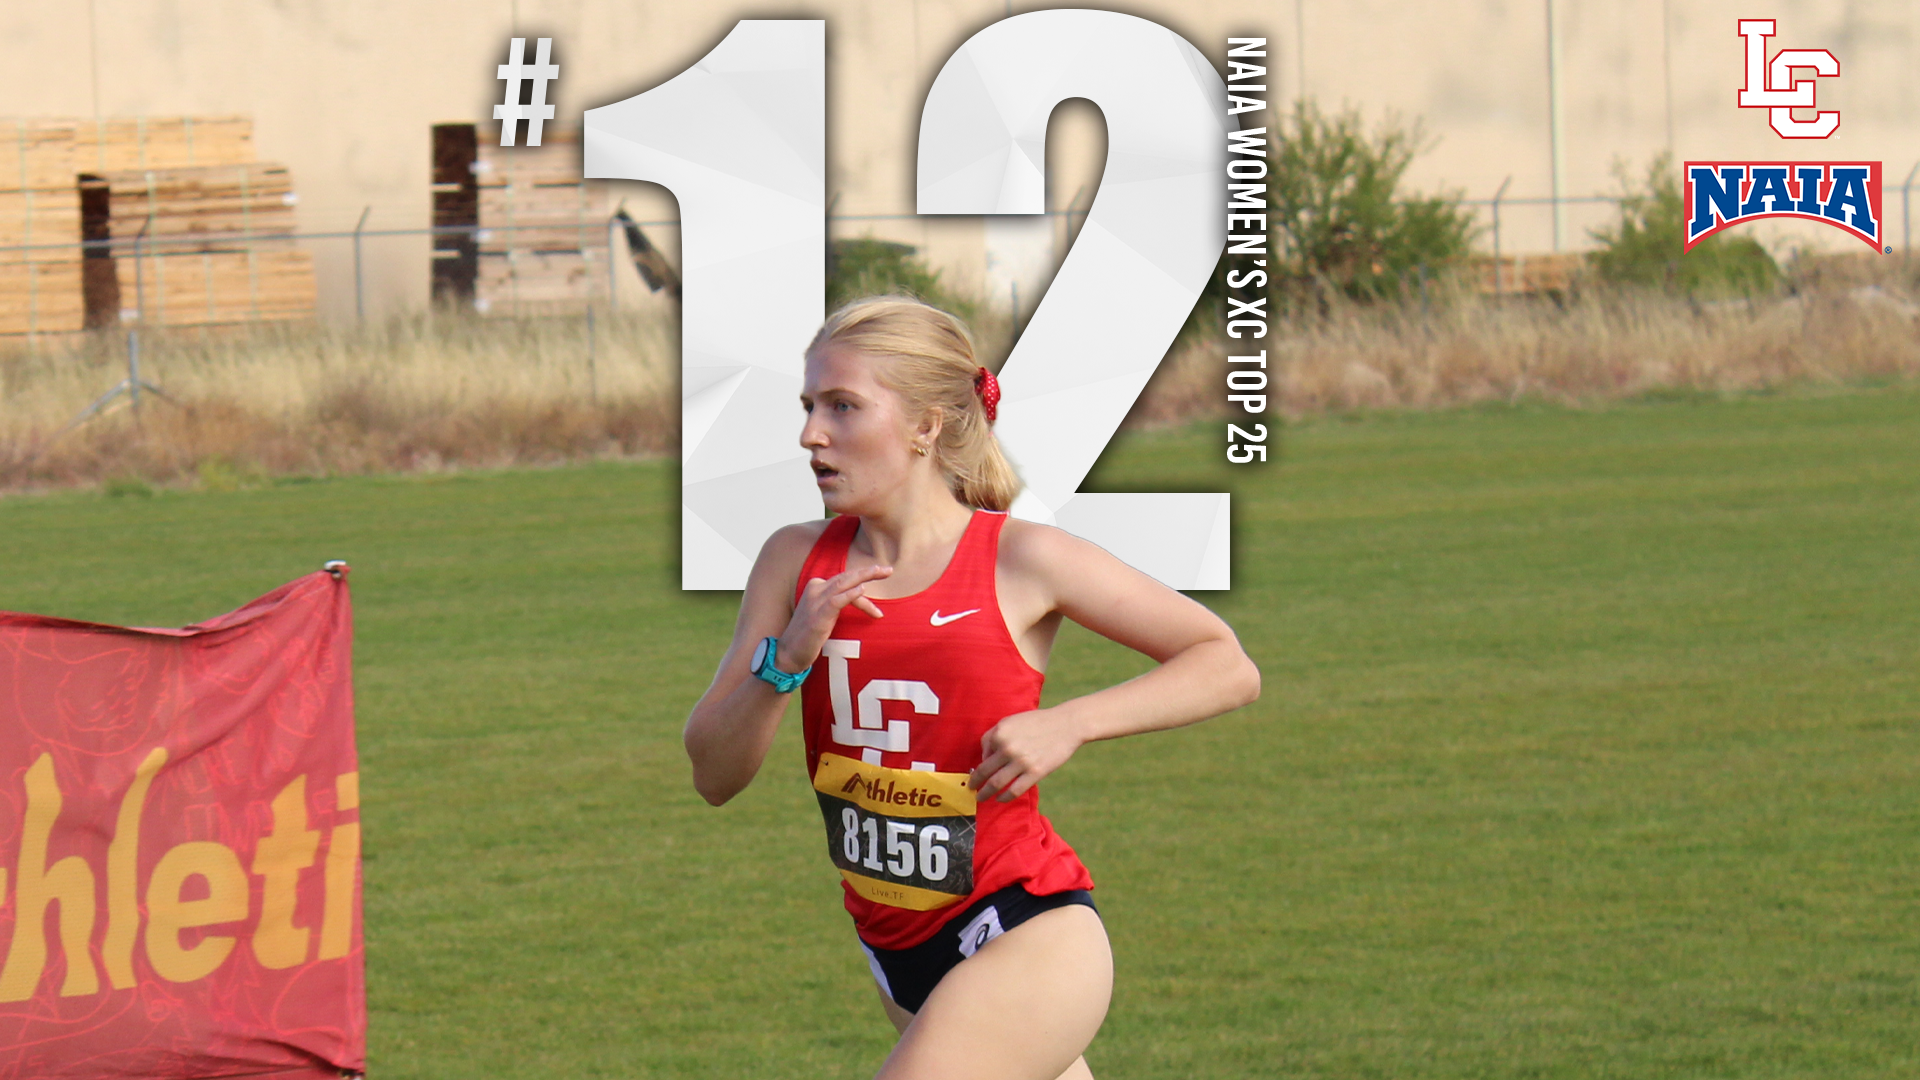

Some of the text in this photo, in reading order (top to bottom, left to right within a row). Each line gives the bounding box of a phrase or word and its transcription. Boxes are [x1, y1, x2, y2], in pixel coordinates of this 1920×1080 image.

[821, 639, 940, 773] LC
[0, 747, 360, 1003] hleti
[841, 807, 950, 881] 8156
